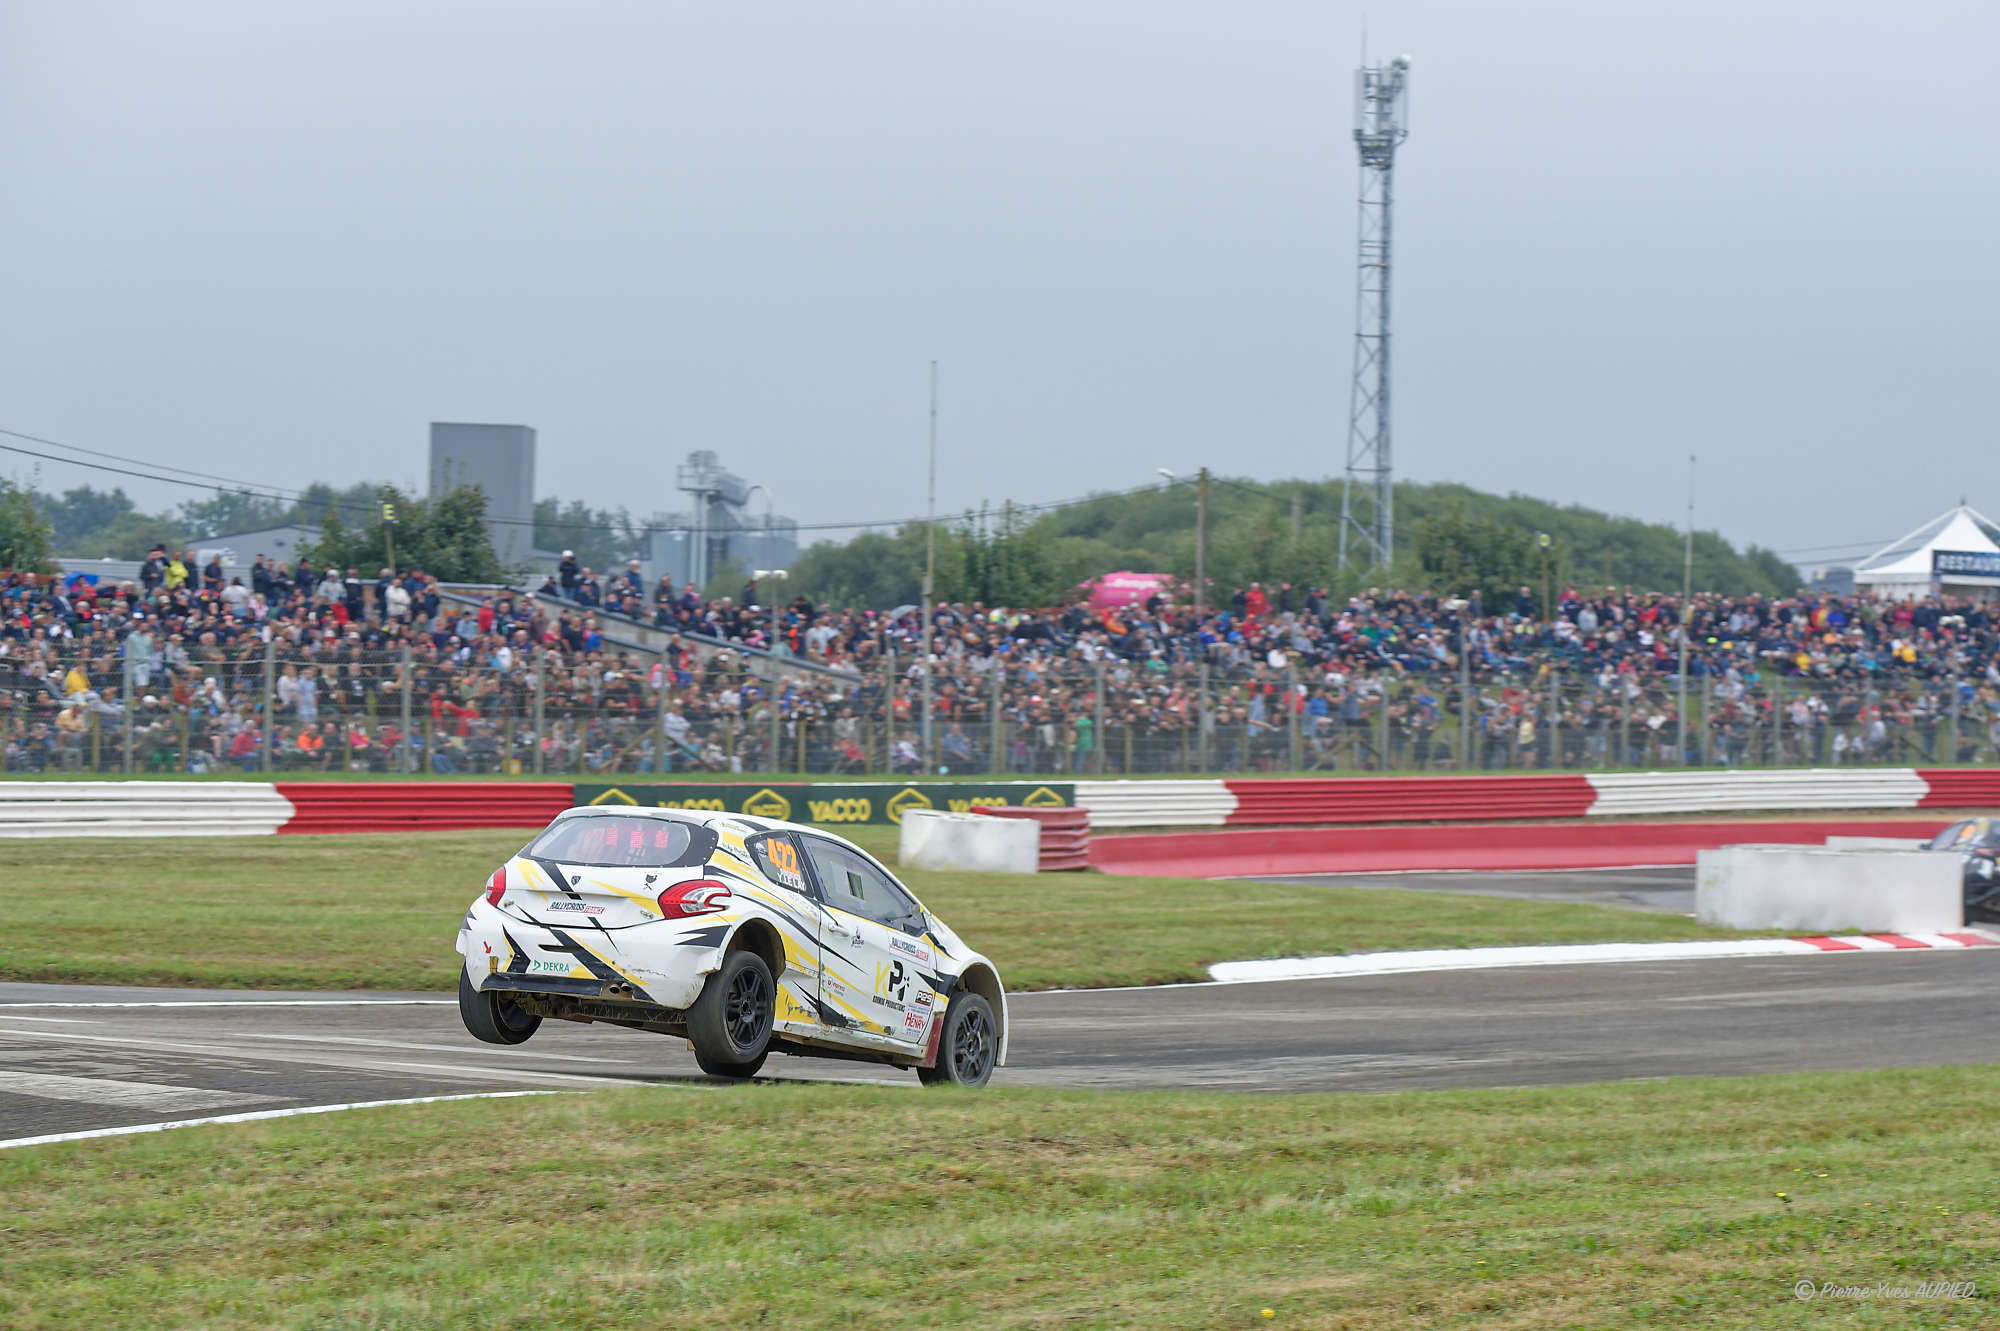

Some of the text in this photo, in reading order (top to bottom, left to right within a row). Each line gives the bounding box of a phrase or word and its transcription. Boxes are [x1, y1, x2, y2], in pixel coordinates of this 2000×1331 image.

[809, 798, 871, 822] YACCO
[766, 837, 801, 875] 422
[549, 901, 586, 911] RALLYCROSS
[543, 962, 570, 973] DEKRA
[904, 1012, 926, 1031] HENRY
